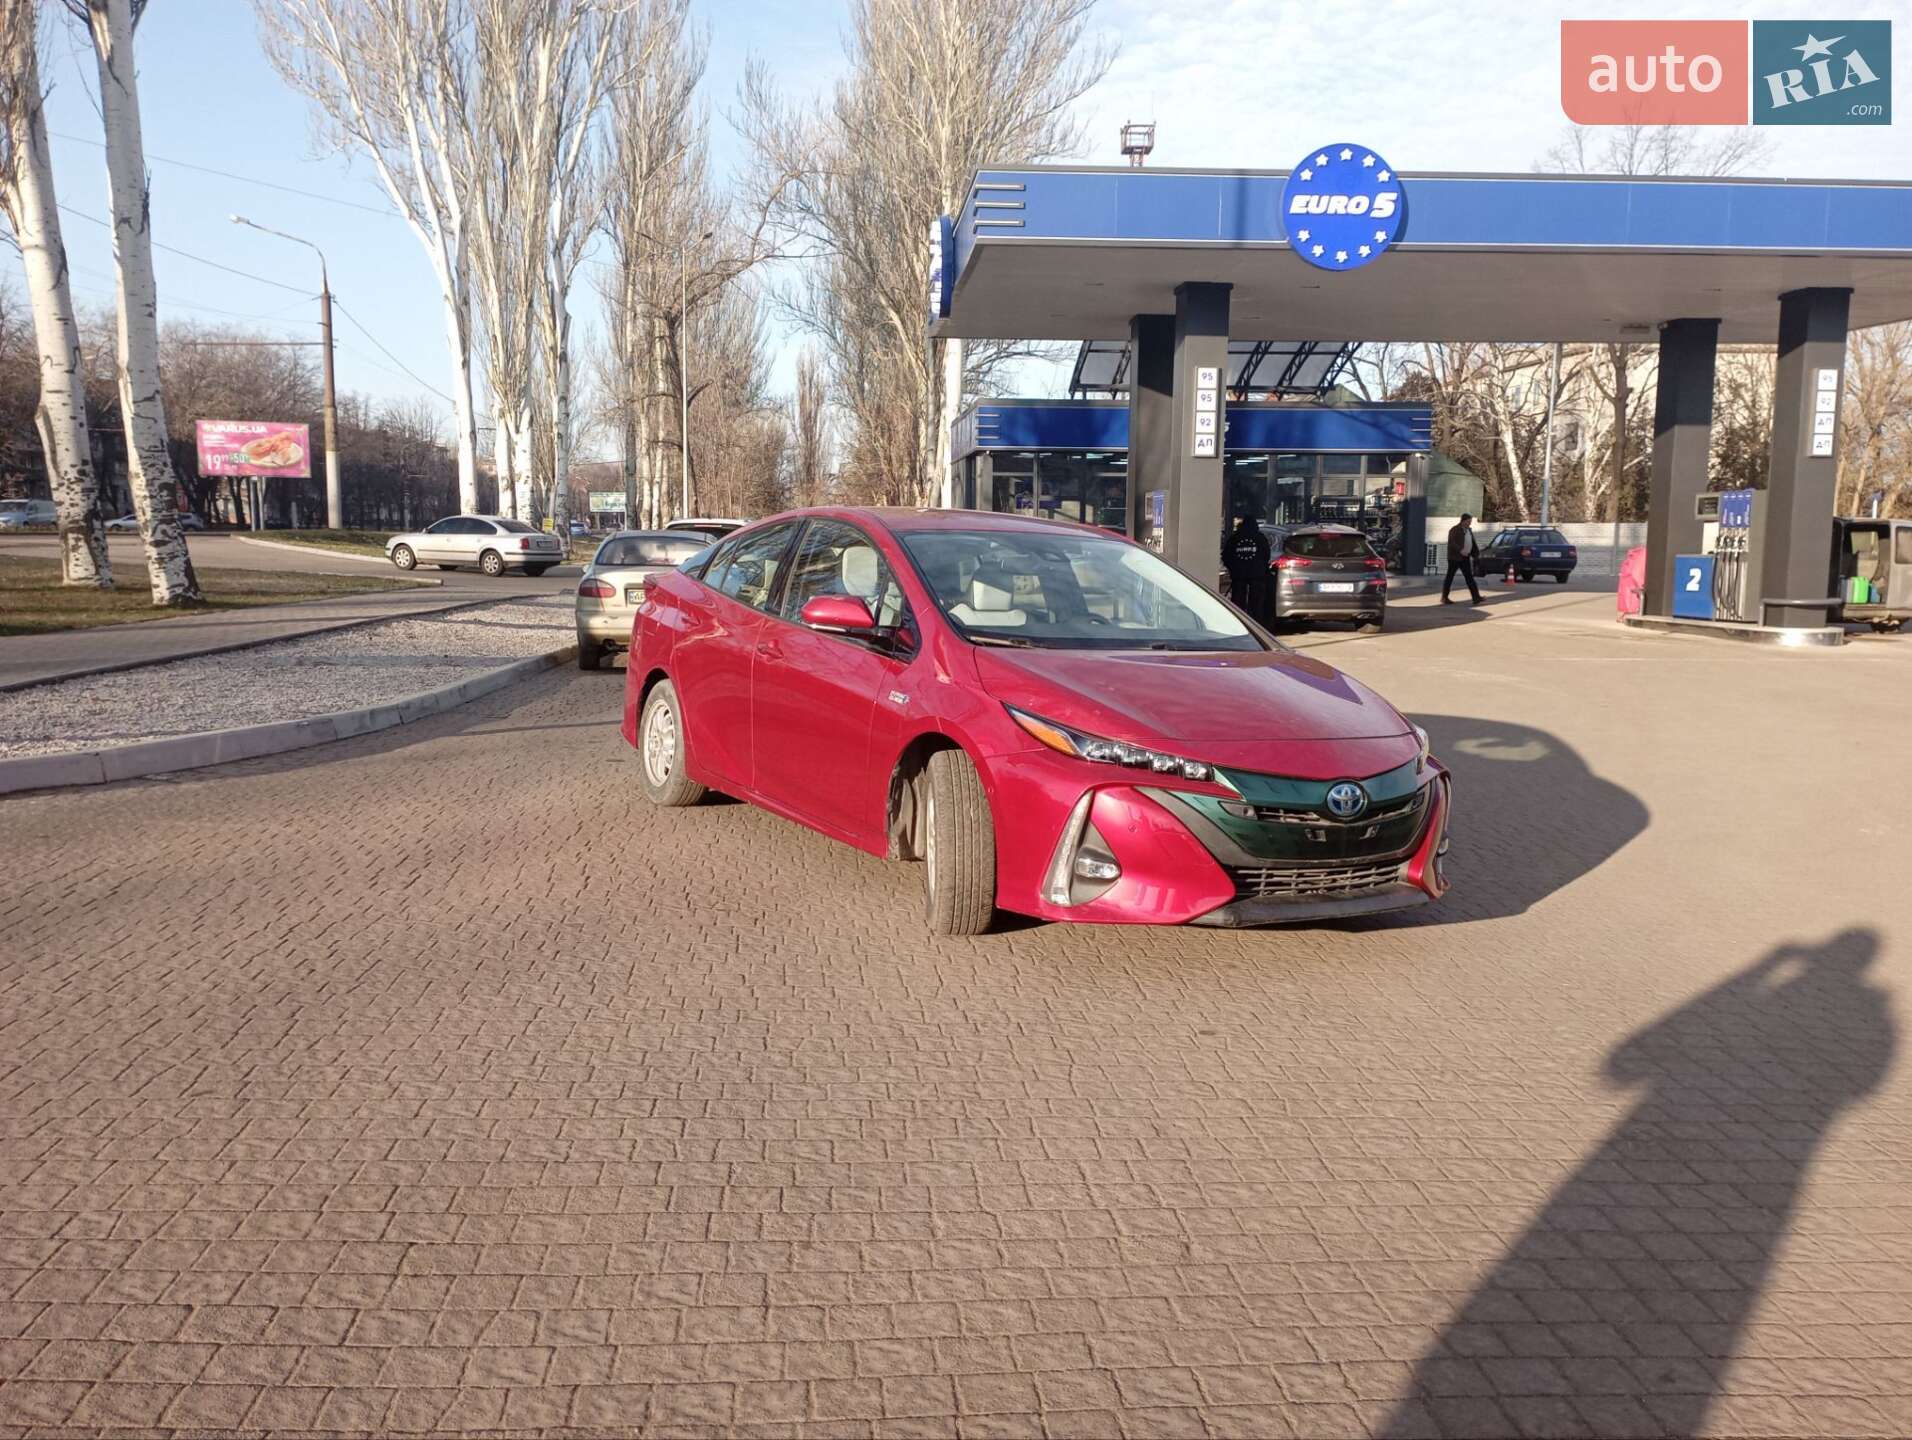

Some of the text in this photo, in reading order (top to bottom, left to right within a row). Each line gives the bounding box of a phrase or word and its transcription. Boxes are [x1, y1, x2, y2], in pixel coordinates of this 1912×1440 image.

[1289, 192, 1398, 218] EURO 5
[1202, 372, 1213, 381] 95
[1200, 394, 1212, 402] 95
[1200, 418, 1211, 426] 92
[1198, 438, 1213, 448] ДП
[1685, 567, 1702, 592] 2
